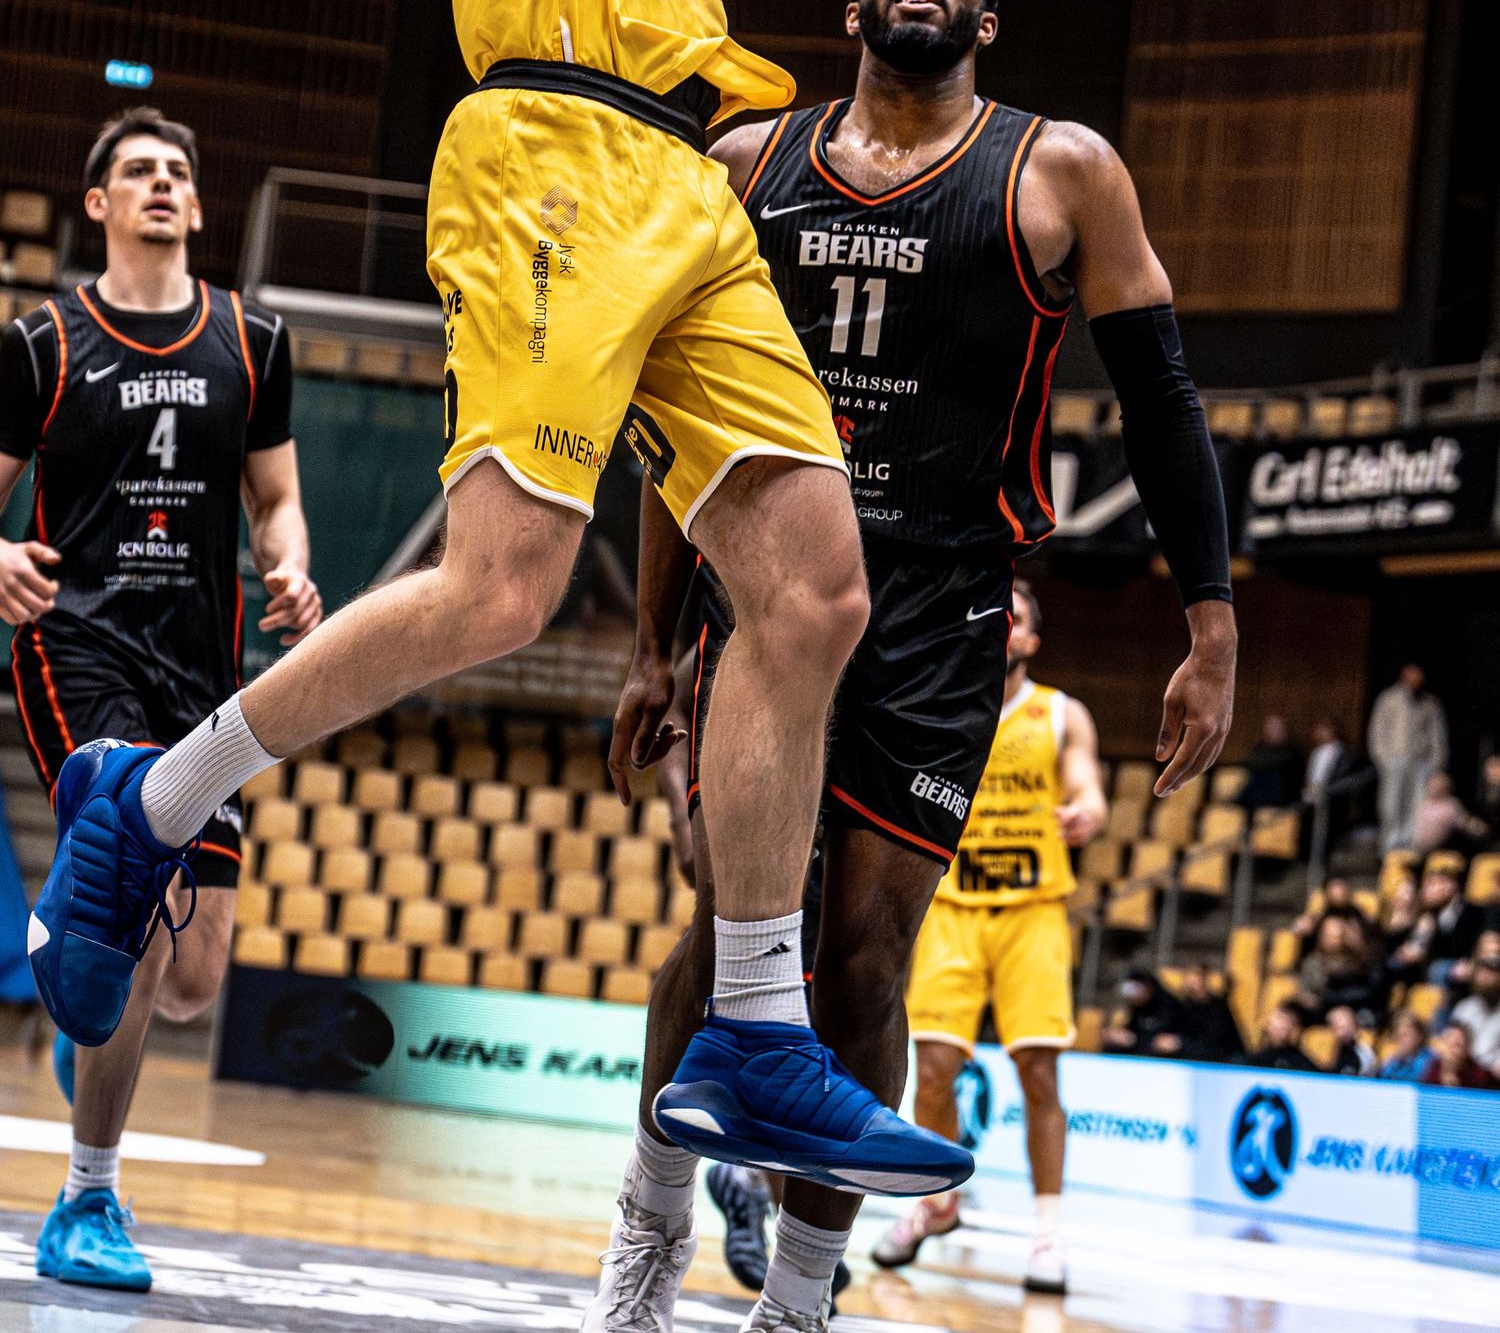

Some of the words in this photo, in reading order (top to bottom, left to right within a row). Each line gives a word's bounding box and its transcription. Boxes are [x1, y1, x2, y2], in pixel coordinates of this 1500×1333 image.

[832, 222, 900, 236] BAKKEN
[556, 242, 576, 275] Jysk
[799, 230, 929, 274] BEARS
[528, 239, 553, 364] Byggekompagni
[830, 275, 887, 358] 11
[118, 377, 208, 410] BEARS
[817, 367, 919, 395] rekassen
[831, 393, 890, 412] MARK
[146, 407, 179, 470] 4
[850, 462, 890, 481] LIG
[857, 506, 903, 522] GROUP
[910, 771, 970, 821] BEARS
[407, 1034, 528, 1069] JENS
[541, 1049, 643, 1082] KAR
